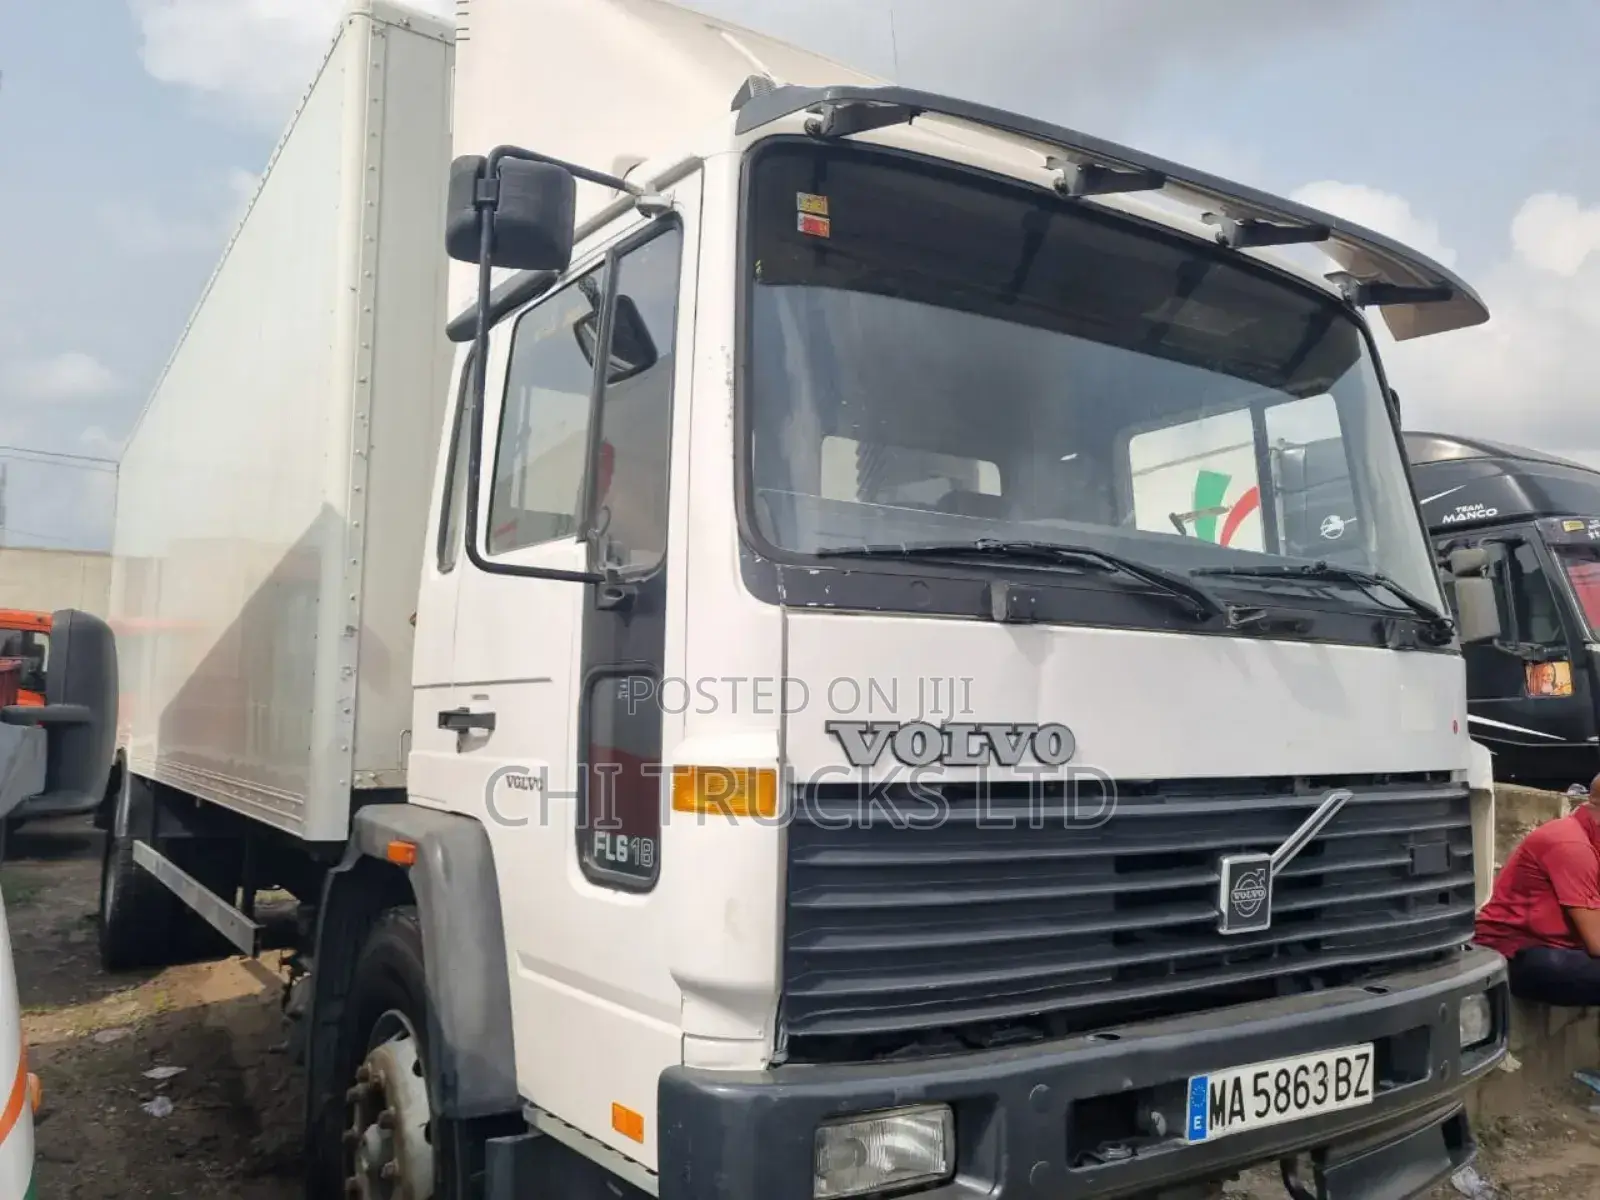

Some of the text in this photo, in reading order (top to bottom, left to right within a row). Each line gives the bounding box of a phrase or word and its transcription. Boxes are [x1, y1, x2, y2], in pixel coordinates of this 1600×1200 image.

[1455, 503, 1484, 513] TEAM
[1442, 508, 1498, 524] MANCO
[825, 720, 1076, 767] VOLVO
[506, 775, 544, 792] VOLVO
[1232, 889, 1265, 900] VOLVO
[1193, 1115, 1202, 1130] E
